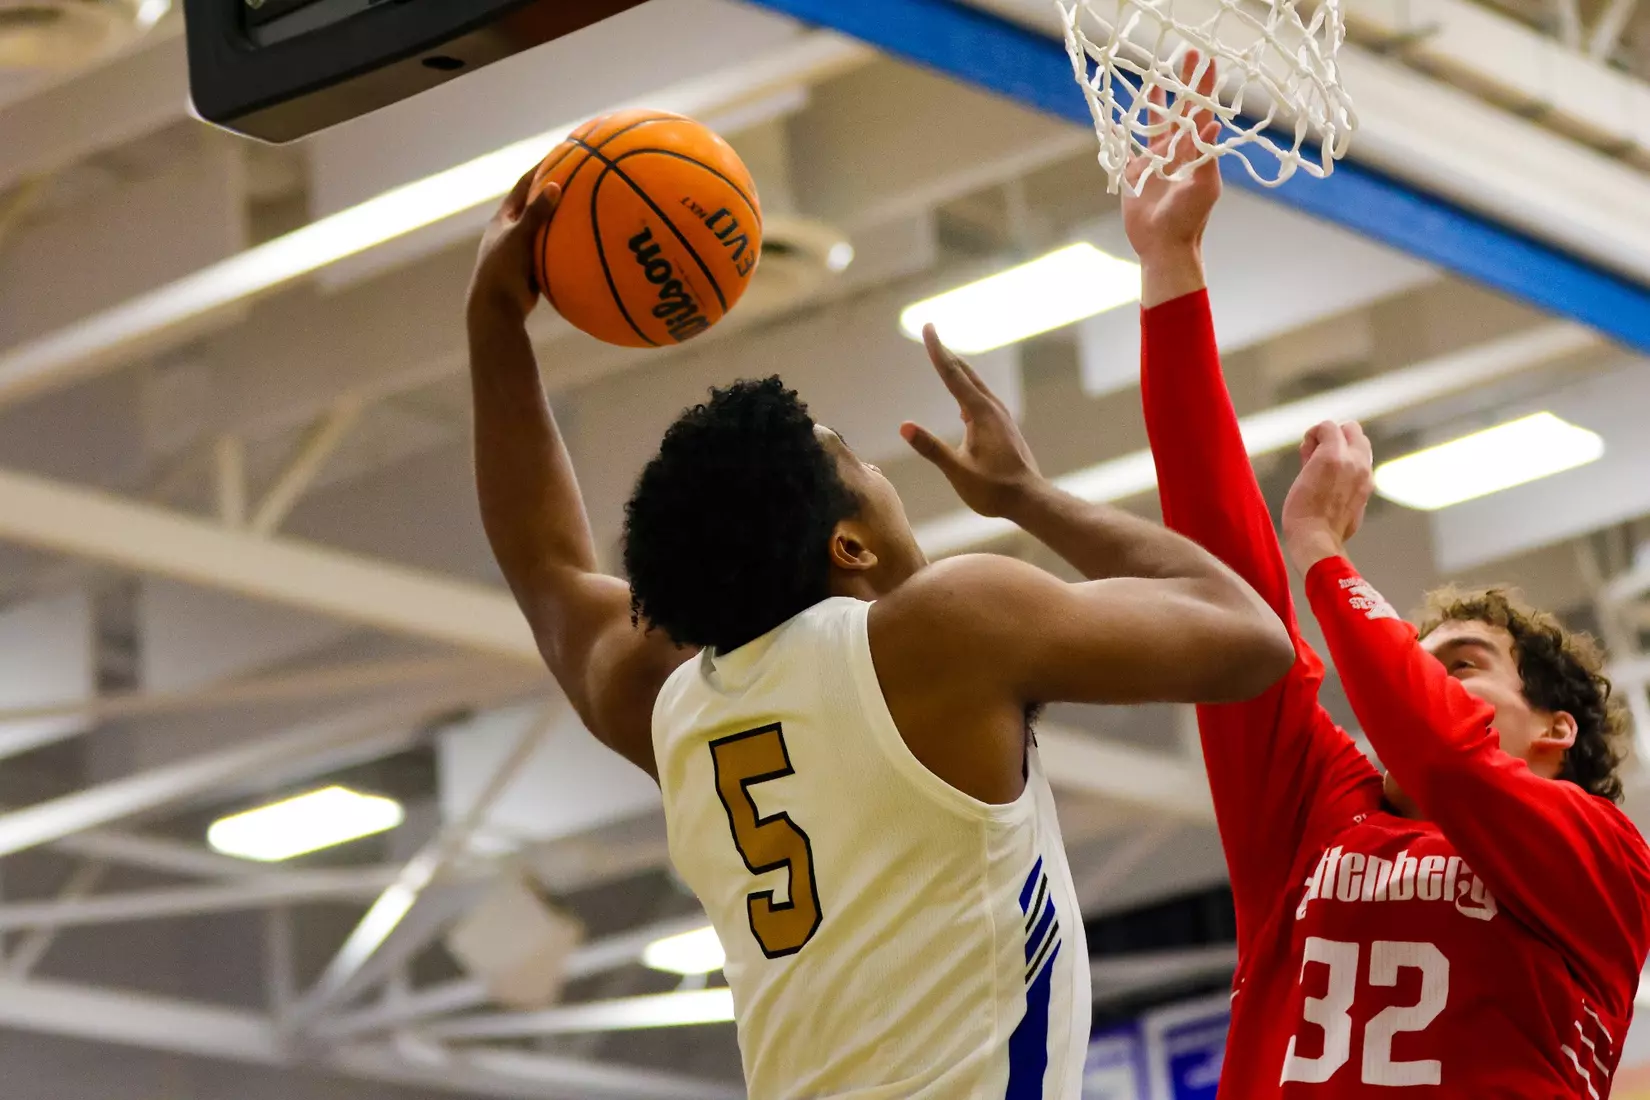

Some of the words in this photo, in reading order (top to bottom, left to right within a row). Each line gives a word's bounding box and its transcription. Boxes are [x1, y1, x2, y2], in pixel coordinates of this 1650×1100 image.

[628, 226, 711, 342] Wilson
[704, 207, 755, 278] EVO
[709, 721, 823, 959] 5
[1295, 845, 1499, 922] ttenberg
[1279, 936, 1450, 1087] 32
